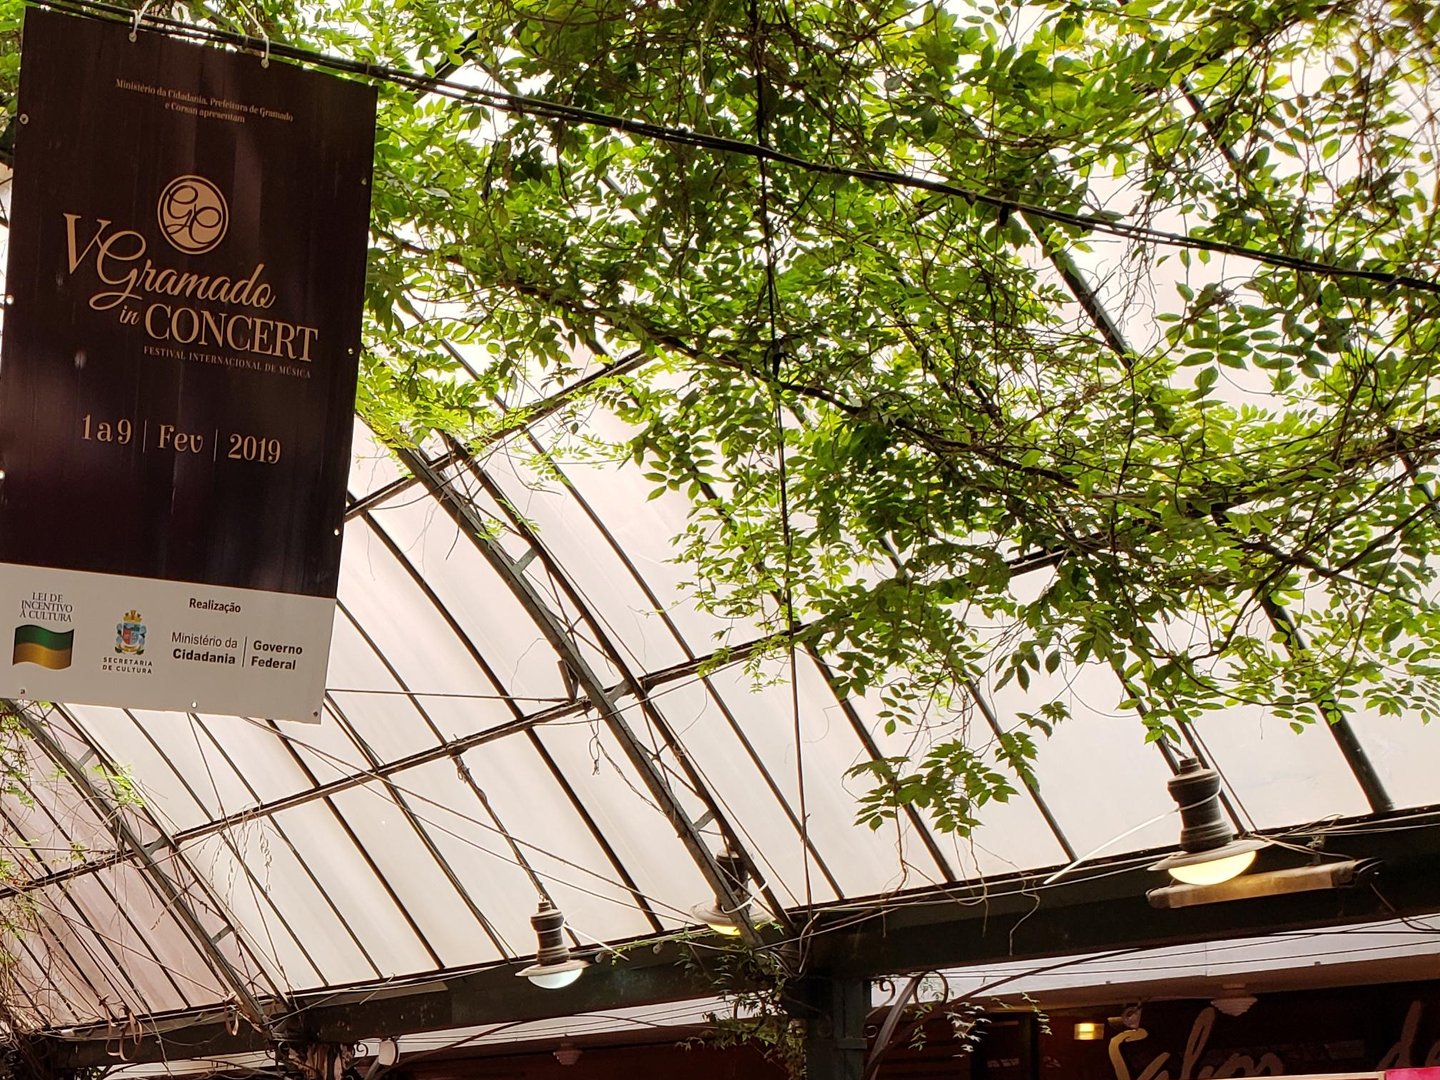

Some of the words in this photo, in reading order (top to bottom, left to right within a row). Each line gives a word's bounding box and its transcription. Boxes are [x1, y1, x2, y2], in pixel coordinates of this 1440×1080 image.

[248, 104, 259, 115] de
[259, 107, 294, 122] Gramado
[62, 212, 112, 275] V
[89, 230, 277, 311] Gramado
[118, 305, 141, 326] in
[144, 303, 319, 363] CONCERT
[143, 345, 186, 361] FESTIVAL
[188, 354, 262, 371] INTERNACIONAL
[264, 362, 277, 374] DE
[157, 424, 204, 454] Fev
[227, 432, 282, 464] 2019
[32, 591, 48, 602] LEI
[49, 593, 64, 603] DE
[188, 597, 242, 614] Realização
[21, 600, 73, 614] INCENTIVO
[28, 609, 73, 623] CULTURA
[171, 631, 222, 648] Ministério
[224, 636, 238, 649] da
[253, 640, 303, 656] Governo
[103, 656, 153, 667] SECRETARIA
[172, 648, 236, 665] Cidadania
[251, 656, 297, 671] Federal
[102, 664, 113, 672] DE
[115, 665, 153, 675] CULTURA
